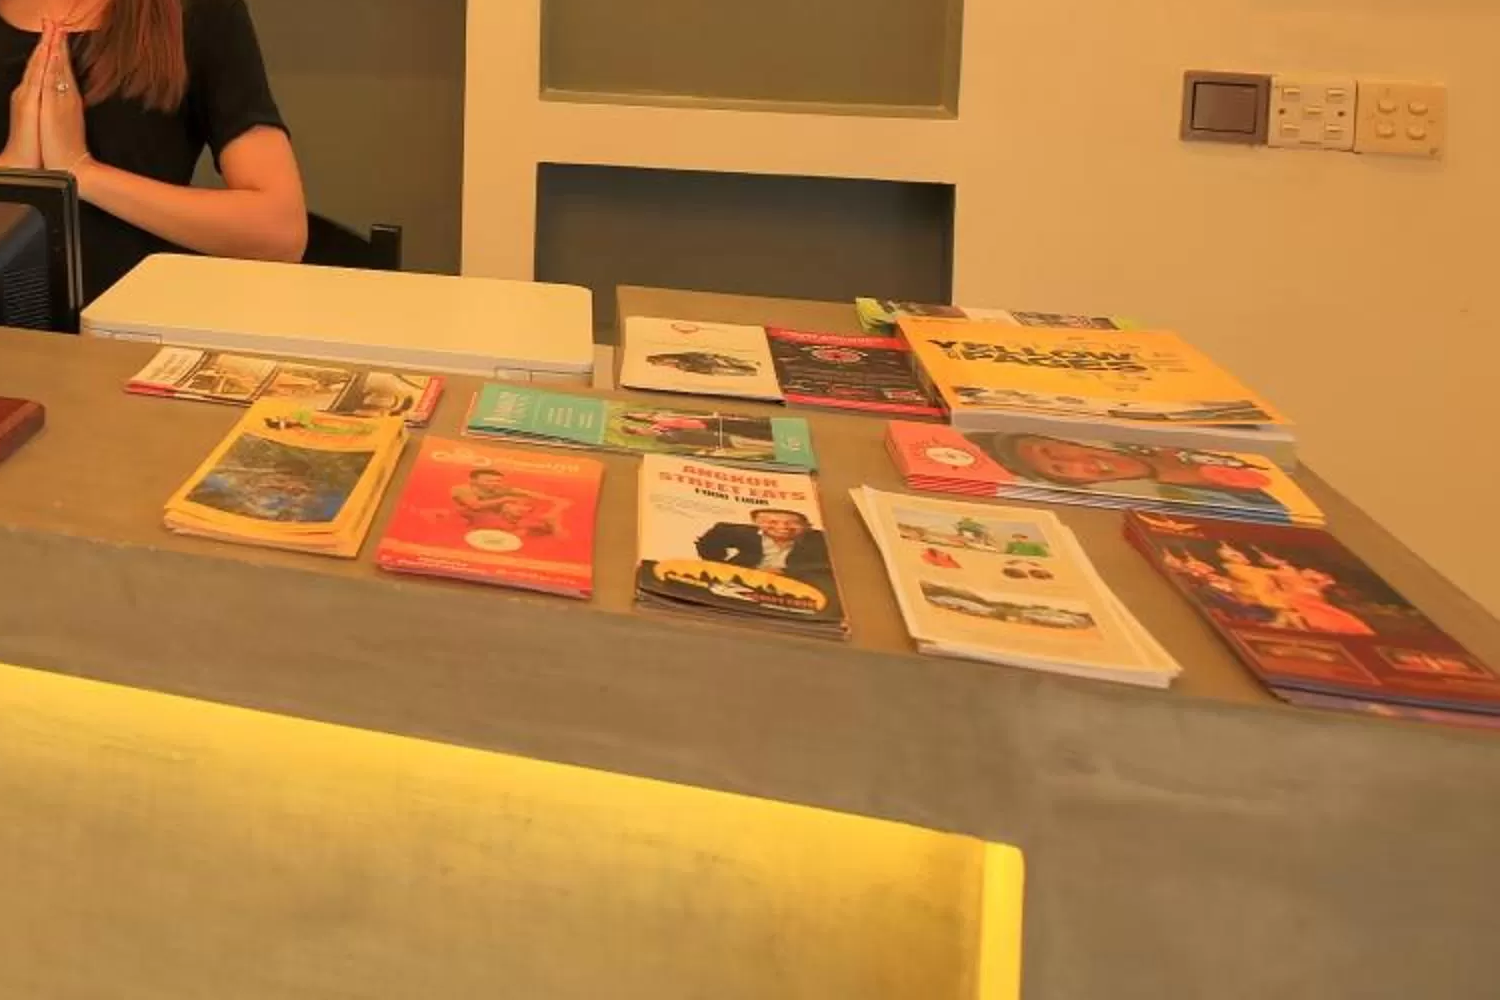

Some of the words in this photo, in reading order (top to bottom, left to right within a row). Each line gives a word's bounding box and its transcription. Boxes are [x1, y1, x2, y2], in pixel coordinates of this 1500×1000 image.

[928, 339, 1132, 361] YELLOW
[658, 471, 741, 495] STREET
[749, 487, 806, 501] EATS
[683, 465, 779, 488] ANGKOR
